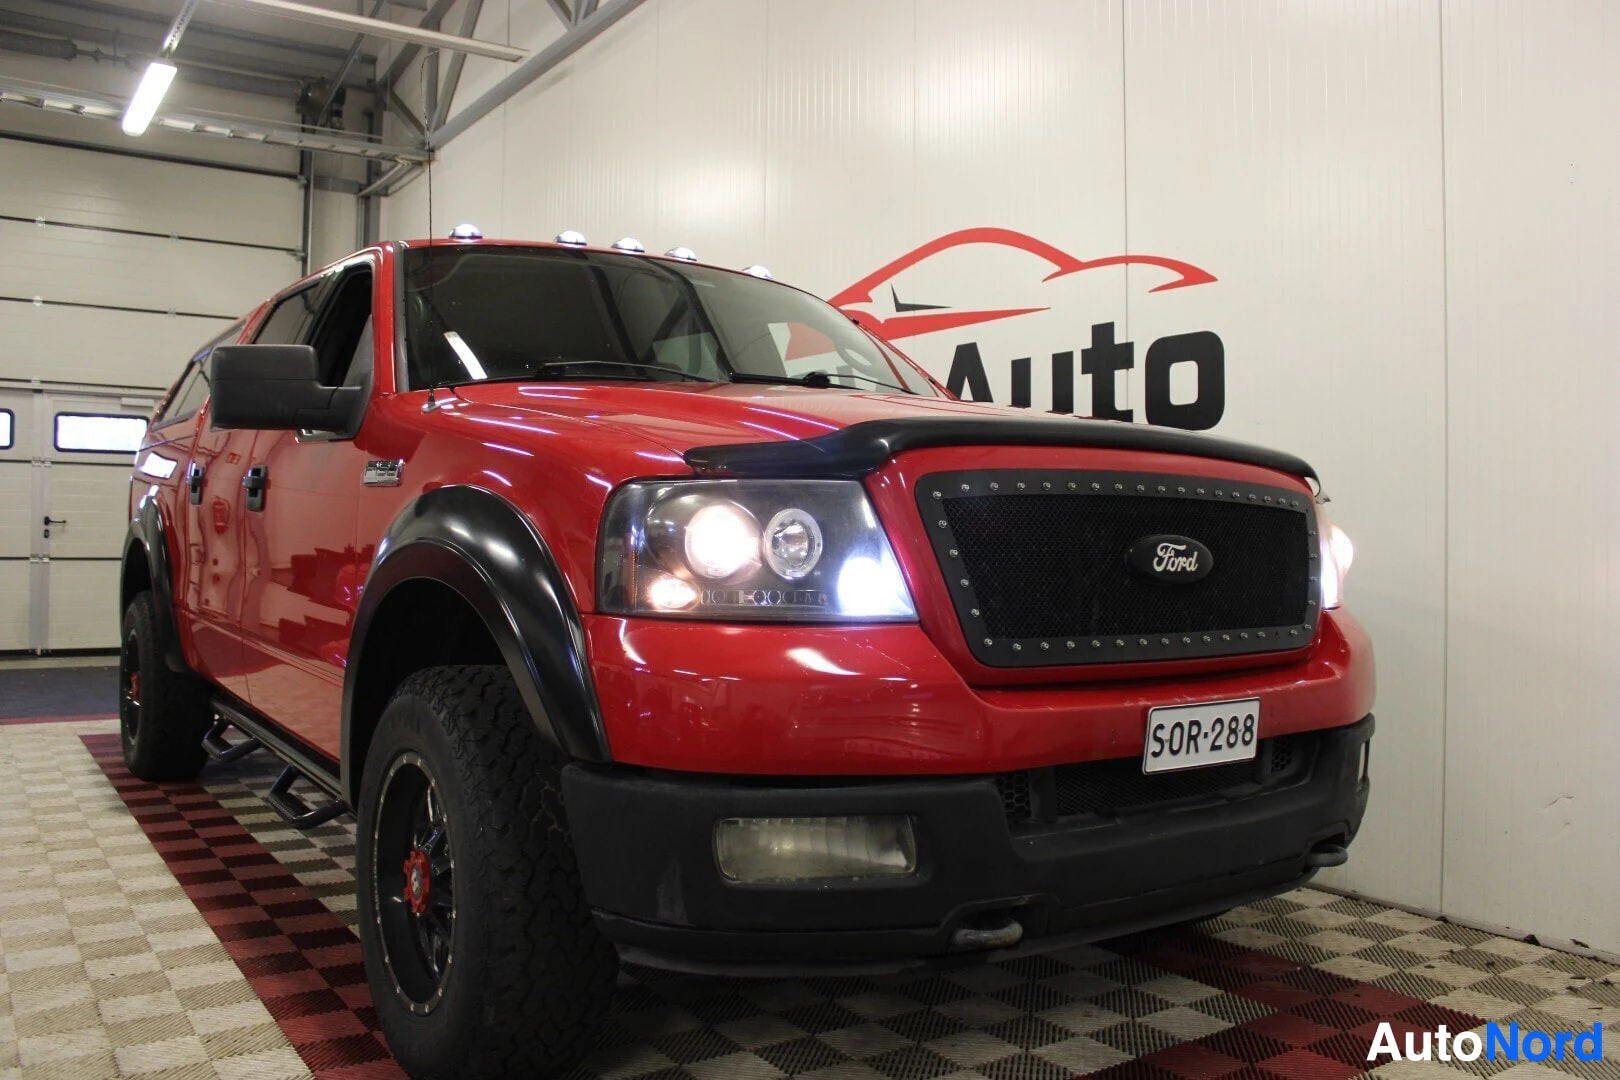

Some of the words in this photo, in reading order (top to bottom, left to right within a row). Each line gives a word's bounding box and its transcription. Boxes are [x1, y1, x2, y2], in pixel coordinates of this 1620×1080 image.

[946, 321, 1225, 431] Auto
[1153, 542, 1199, 572] Ford
[1151, 713, 1255, 758] SOR-288
